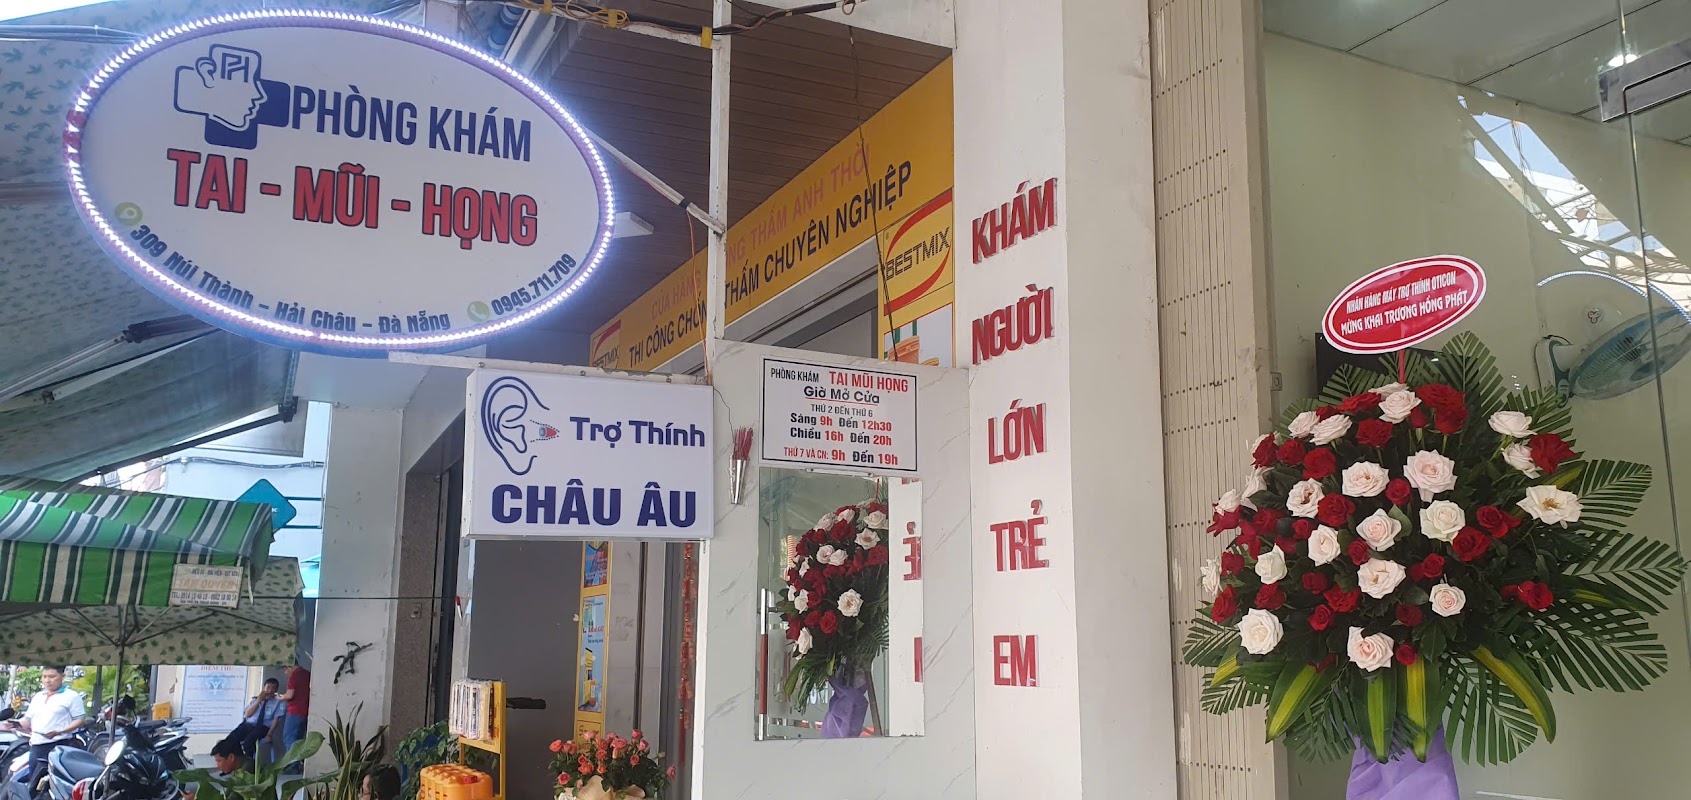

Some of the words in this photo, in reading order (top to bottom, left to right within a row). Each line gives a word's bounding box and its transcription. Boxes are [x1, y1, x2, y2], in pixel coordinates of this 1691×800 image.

[292, 84, 418, 146] PHÒNG
[428, 106, 532, 162] KHÁM
[167, 147, 248, 214] TAI
[292, 162, 380, 229] MŨI
[421, 182, 538, 250] HỌNG
[792, 178, 823, 222] ANH
[972, 177, 1058, 264] KHÁM
[725, 259, 759, 309] THẤM
[764, 215, 829, 283] CHUYÊN
[835, 160, 911, 239] NGHIỆP
[885, 226, 950, 281] BESTMIX
[130, 225, 167, 257] 309
[163, 251, 199, 281] Núi
[198, 271, 254, 310] Thành
[274, 301, 305, 324] Hải
[311, 309, 356, 332] Châu
[378, 315, 401, 334] Đà
[407, 310, 450, 333] Nẵng
[491, 254, 577, 316] 0945.711.709
[1364, 292, 1382, 308] HÀNG
[1382, 287, 1397, 304] MÁY
[1397, 283, 1410, 300] TRỢ
[1411, 278, 1430, 296] THÍNH
[1431, 270, 1457, 290] OTICON
[629, 337, 643, 368] THI
[646, 320, 674, 358] CÔNG
[677, 292, 708, 338] CHỐN
[972, 283, 1055, 365] NGƯỜI
[1341, 318, 1363, 336] MỪNG
[1364, 313, 1383, 330] KHAI
[1384, 303, 1418, 324] TRƯƠNG
[770, 367, 796, 380] PHÒNG
[797, 371, 819, 383] KHÁM
[829, 371, 848, 386] TAI
[851, 373, 873, 389] MŨI
[877, 378, 909, 393] HỌNG
[804, 386, 827, 398] Giờ
[830, 388, 850, 400] Mở
[853, 390, 880, 404] Cửa
[570, 416, 622, 449] Trợ
[628, 420, 705, 447] Thính
[790, 413, 817, 426] Sáng
[820, 416, 833, 426] 9h
[838, 416, 858, 429] Đến
[861, 420, 892, 432] 12h30
[811, 403, 826, 413] THỨ
[828, 405, 833, 413] 2
[834, 404, 850, 415] ĐẾN
[851, 407, 866, 417] THỨ
[987, 398, 1047, 465] LỚN
[784, 446, 798, 457] THỨ
[800, 449, 804, 458] 7
[806, 448, 816, 459] VÀ
[817, 450, 829, 460] CN:
[831, 449, 846, 461] 9h
[852, 450, 874, 464] Đến
[878, 453, 898, 465] 19h
[824, 430, 844, 442] 16h
[850, 431, 870, 444] Đến
[873, 435, 892, 446] 20h
[491, 478, 622, 526] CHÂU
[636, 482, 696, 528] ÂU
[990, 499, 1050, 572] TRẺ
[993, 635, 1040, 687] EM
